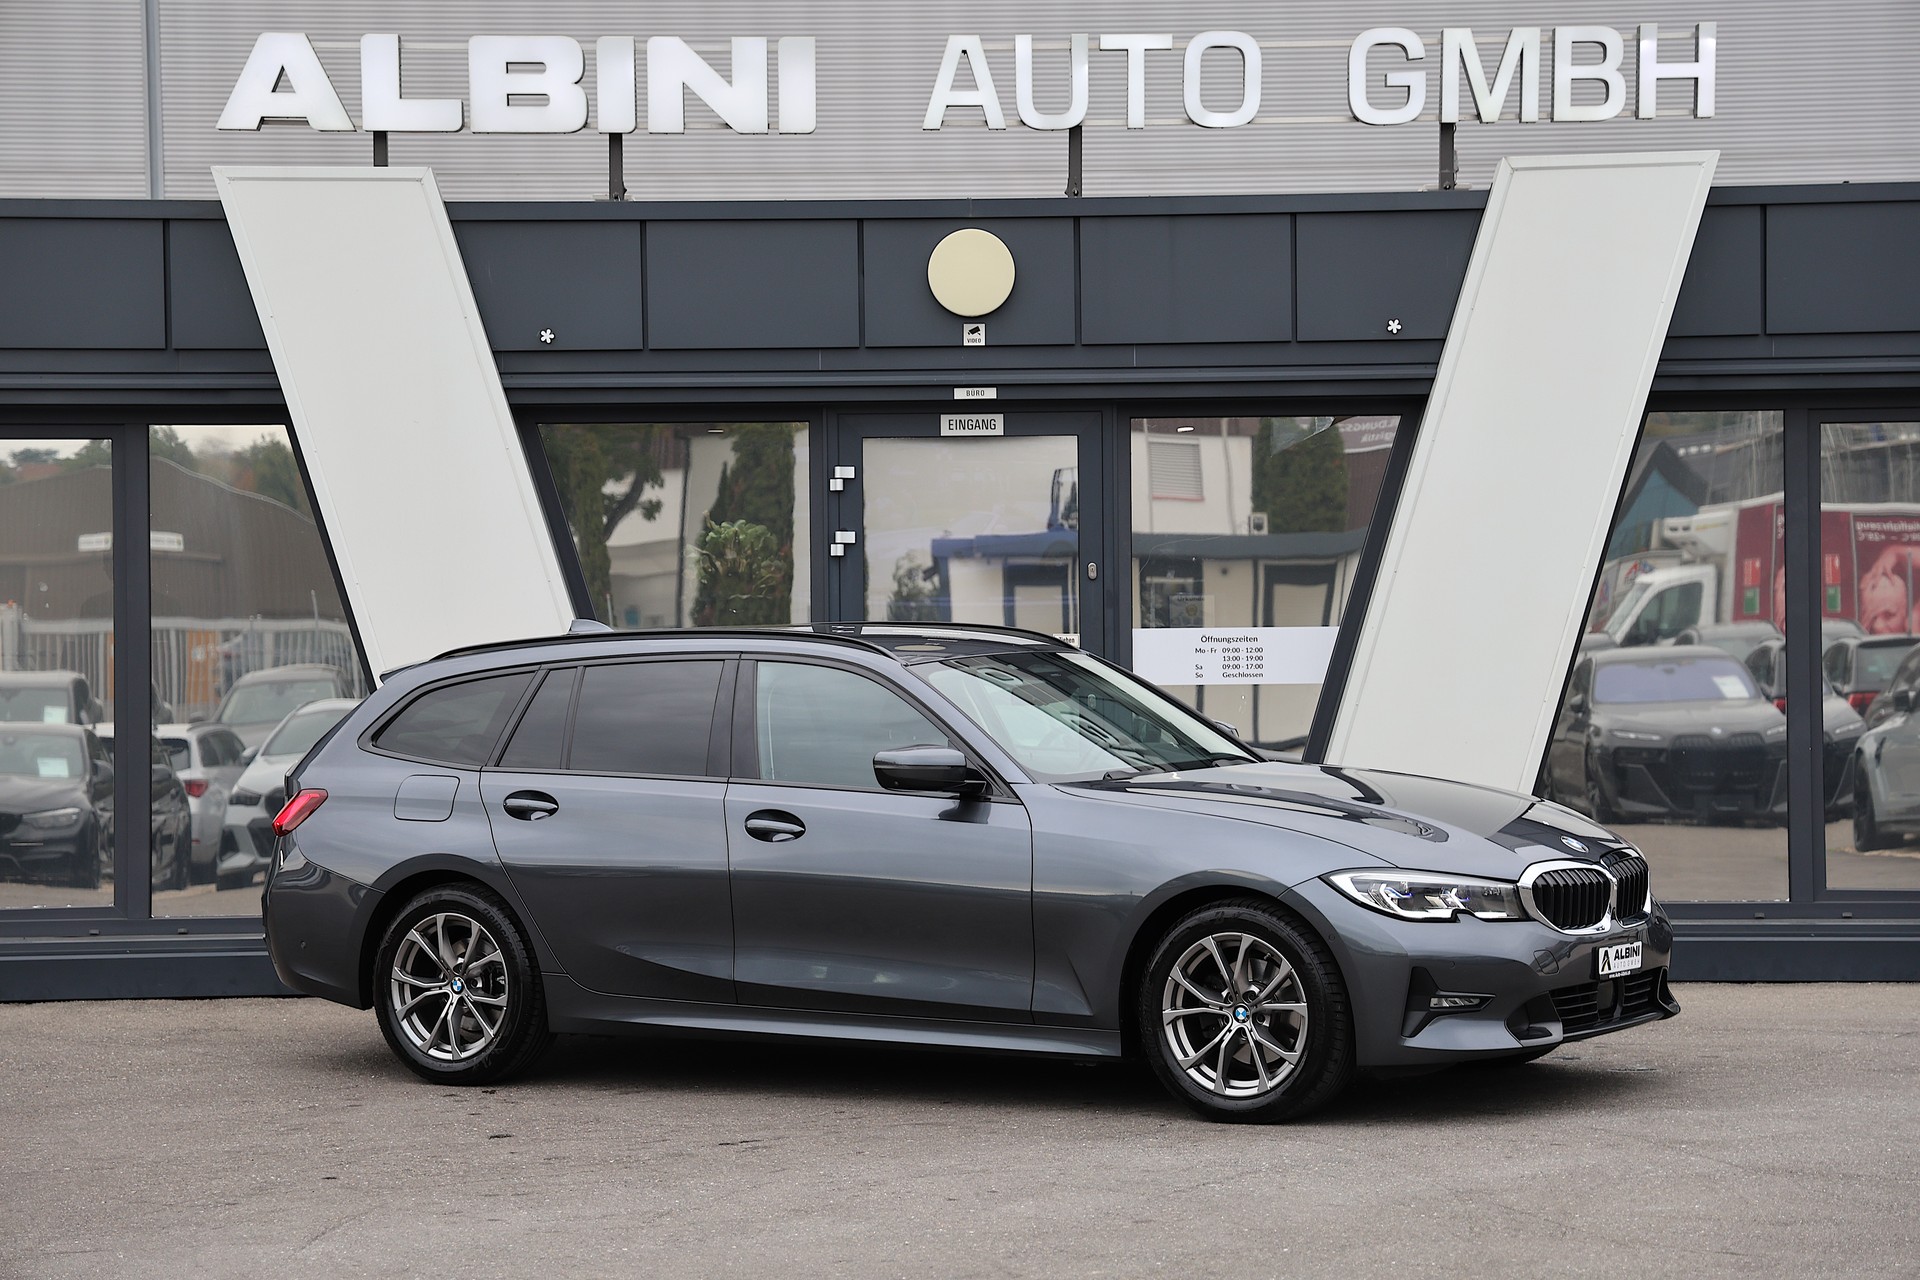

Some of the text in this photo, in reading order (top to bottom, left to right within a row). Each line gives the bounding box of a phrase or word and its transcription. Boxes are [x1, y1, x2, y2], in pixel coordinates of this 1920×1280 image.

[215, 21, 1717, 134] ALBINI AUTO GMBH
[948, 419, 997, 430] EINGANG
[1200, 635, 1258, 644] Öffnungszeiten
[1613, 945, 1641, 961] ALBINI
[1613, 960, 1626, 969] AUTO
